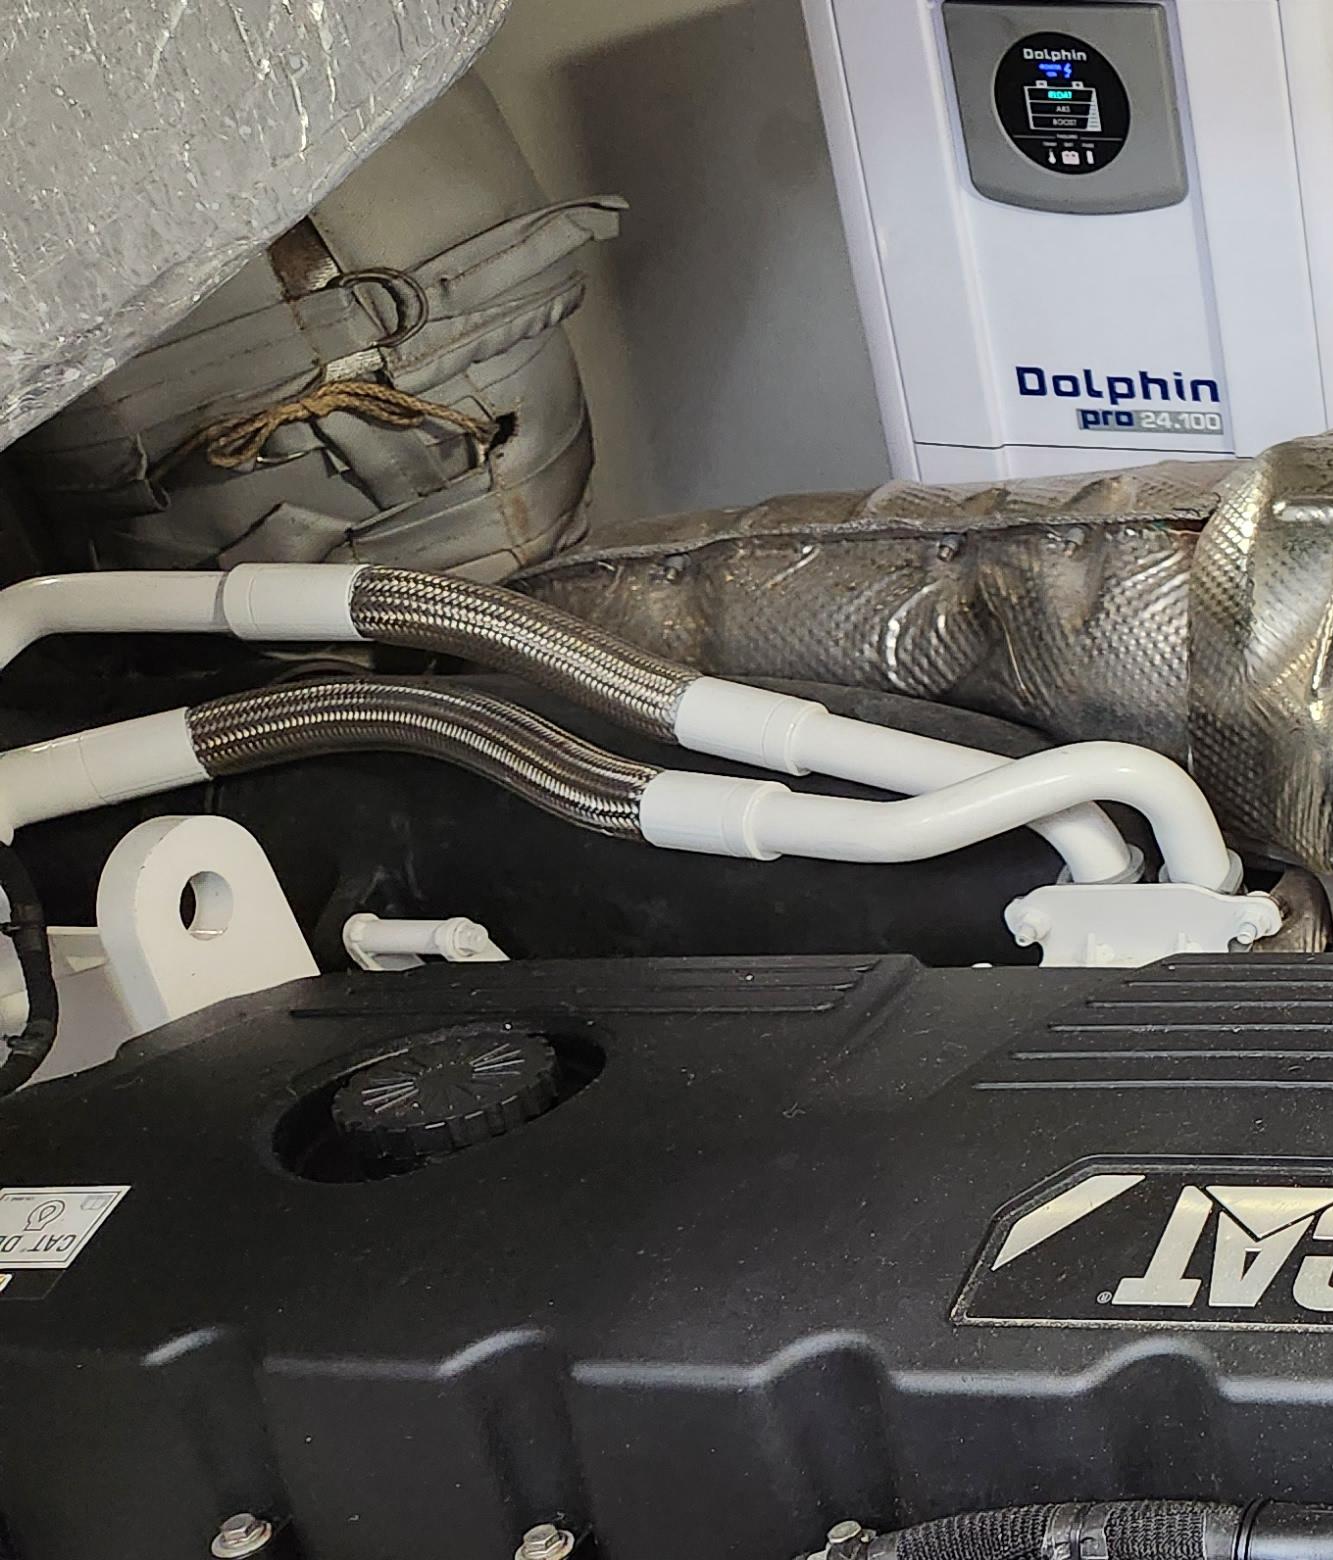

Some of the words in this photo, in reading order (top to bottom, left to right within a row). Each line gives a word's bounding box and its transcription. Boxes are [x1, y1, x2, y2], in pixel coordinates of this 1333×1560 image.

[1023, 48, 1087, 61] Dolphin
[1015, 366, 1220, 405] Dolphin
[1080, 409, 1134, 429] pro
[1140, 411, 1221, 429] 24.100
[26, 1234, 77, 1252] CAT
